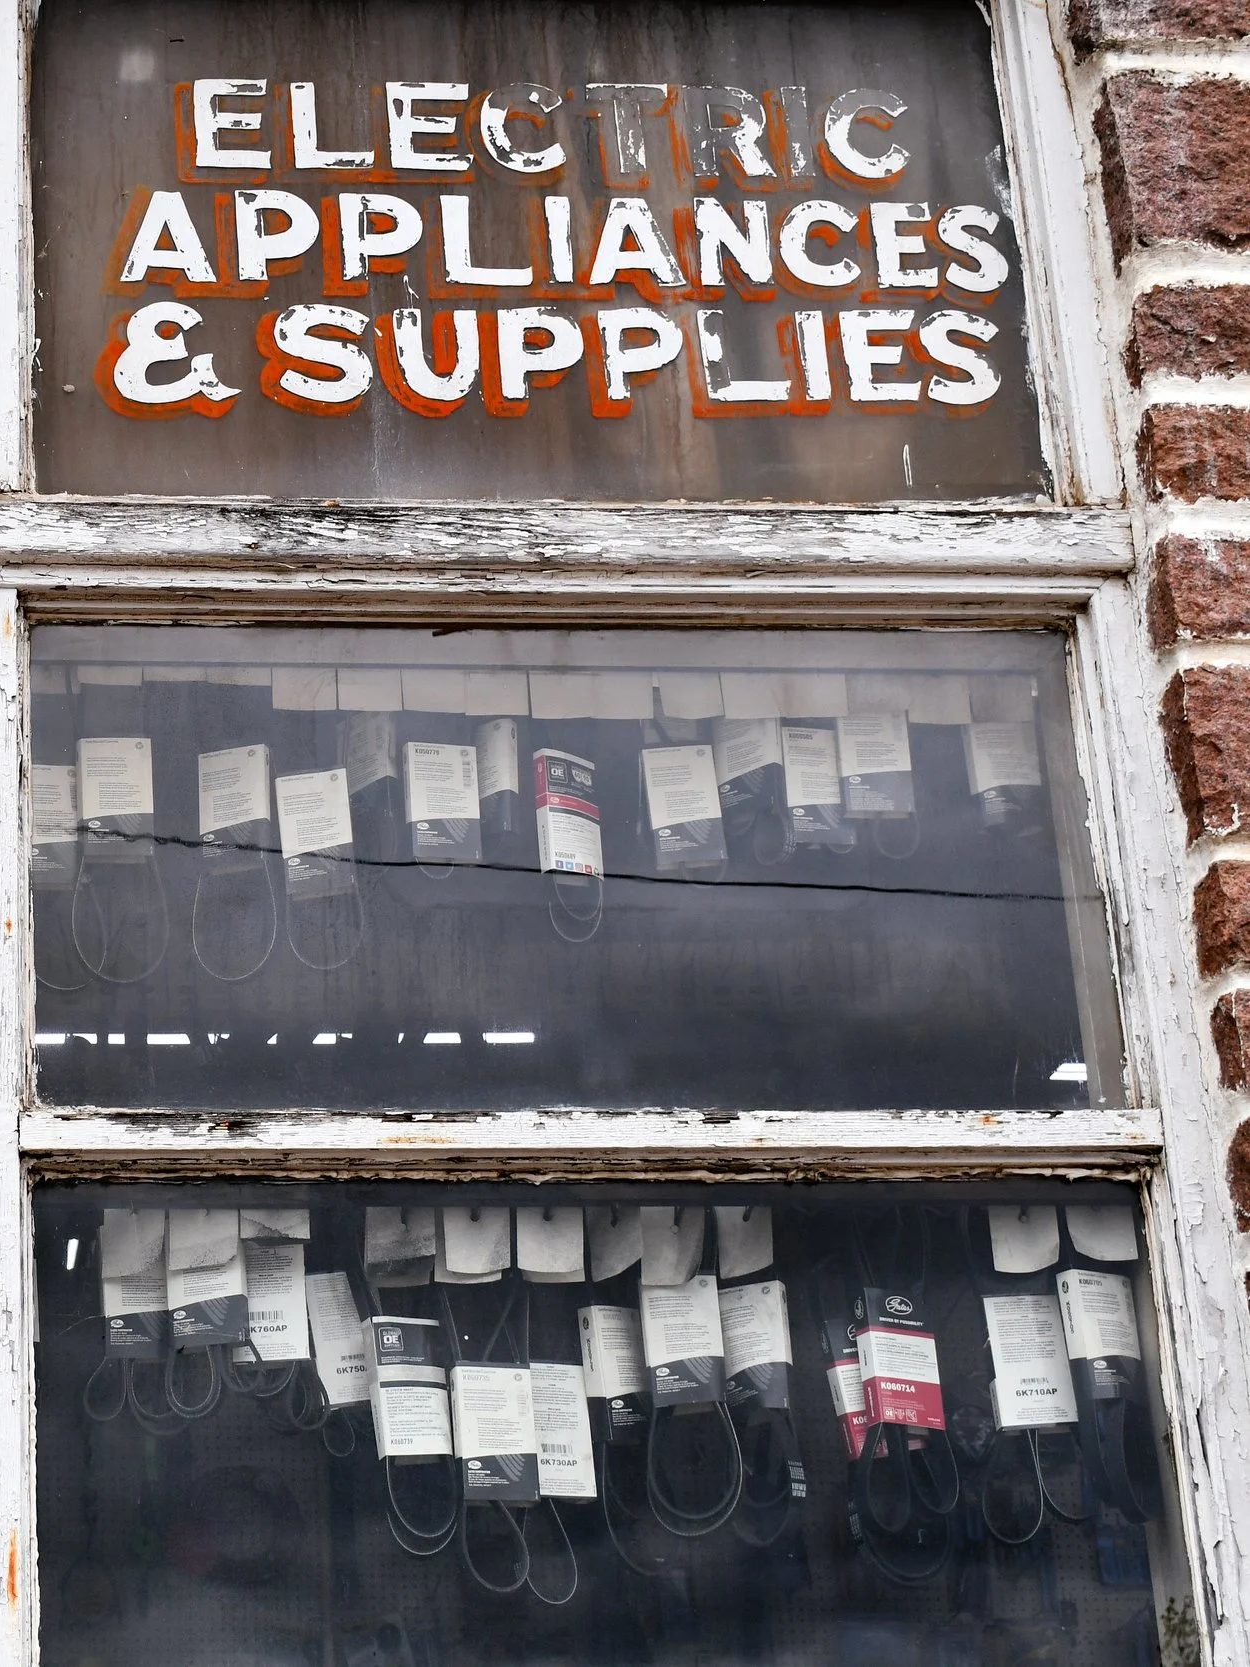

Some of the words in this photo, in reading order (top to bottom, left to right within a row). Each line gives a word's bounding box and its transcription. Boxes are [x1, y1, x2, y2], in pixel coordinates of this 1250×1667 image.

[192, 78, 910, 180] ELECTRIC
[120, 190, 1010, 293] APPLIANCES
[113, 301, 242, 404] &
[275, 307, 1002, 405] SUPPLIES
[383, 1335, 400, 1344] OE
[880, 1381, 916, 1393] K060714
[1015, 1388, 1058, 1397] 6K710AP
[540, 1458, 578, 1467] 6K730AP
